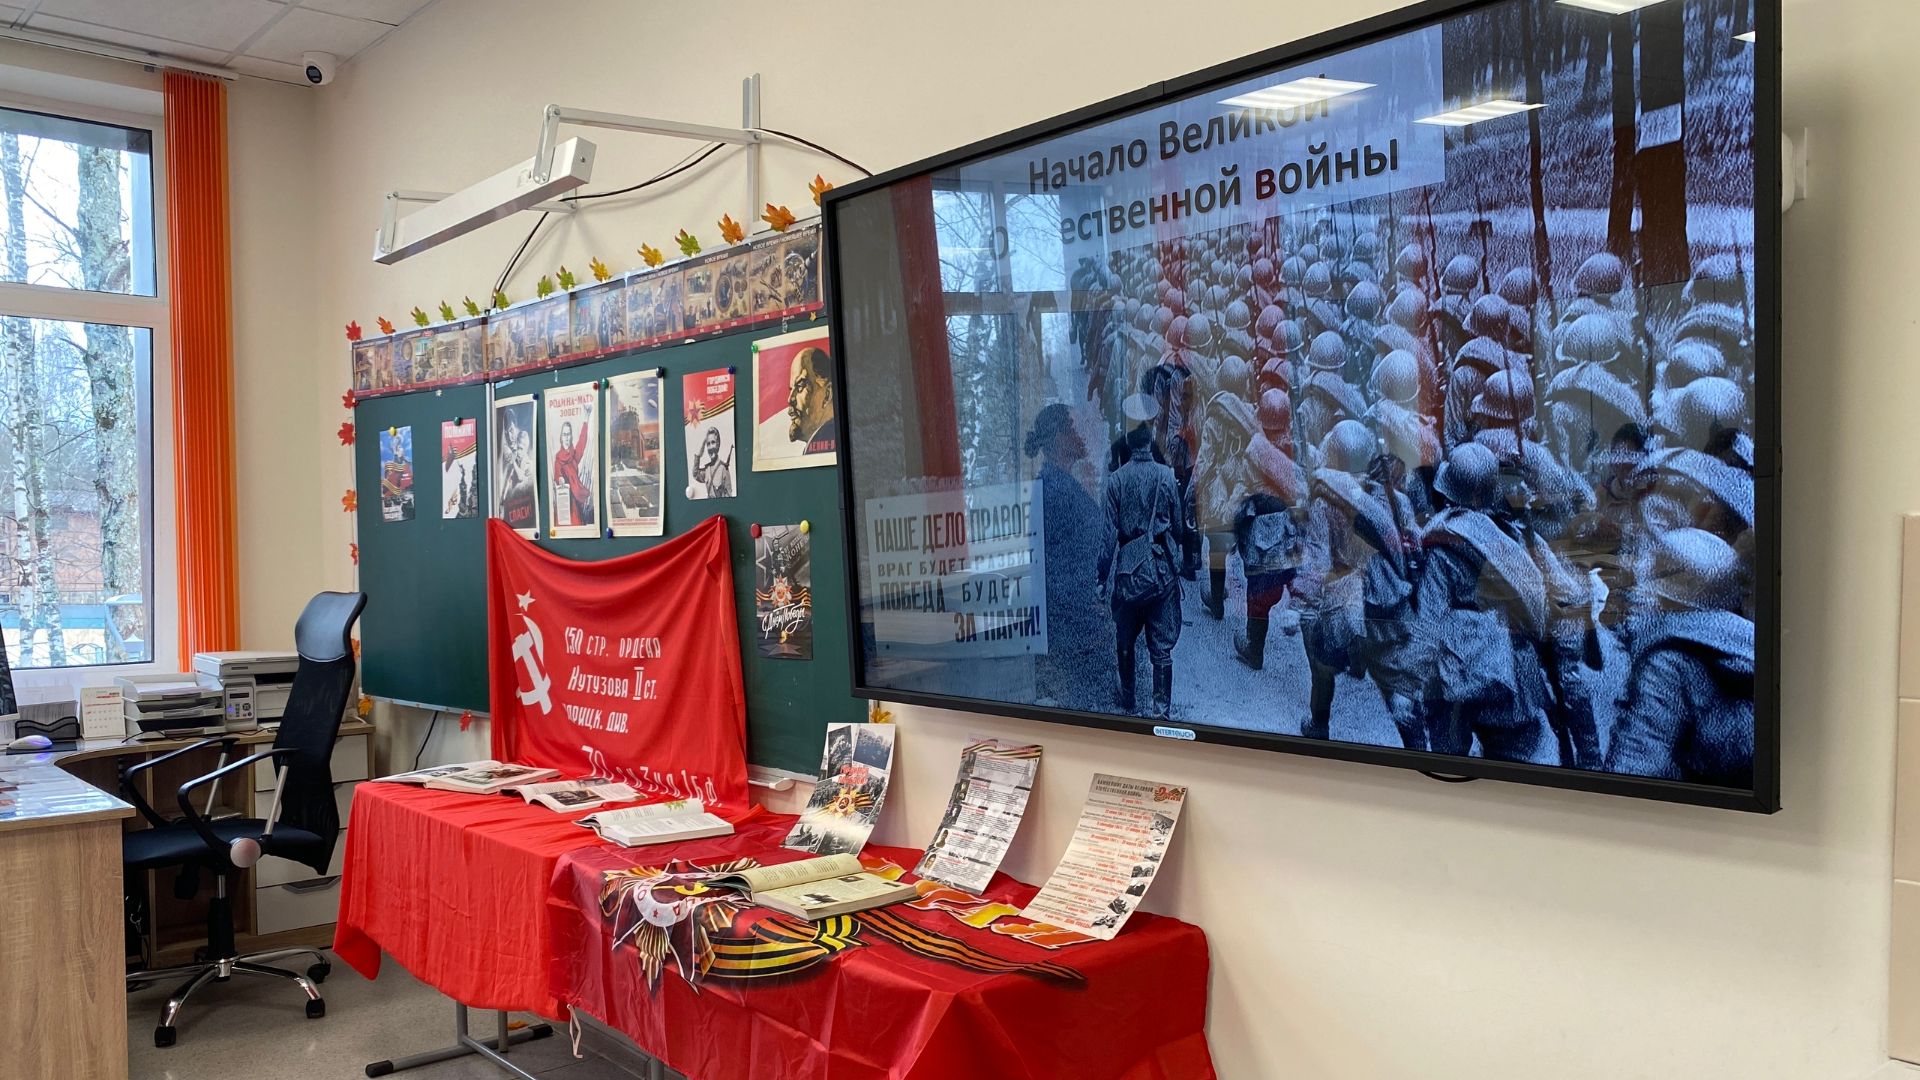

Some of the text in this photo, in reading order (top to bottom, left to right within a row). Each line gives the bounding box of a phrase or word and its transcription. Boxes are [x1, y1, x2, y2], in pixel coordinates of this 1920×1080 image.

[1029, 139, 1148, 194] Начало
[1255, 138, 1398, 200] войны
[874, 515, 919, 553] НАШЕ
[922, 511, 966, 555] ДЕЛО
[877, 562, 913, 578] ВРАГ
[919, 557, 966, 576] БУДЕТ
[879, 576, 1022, 613] ПОБЕДА БУДЕТ
[565, 626, 584, 655] 150
[953, 605, 1041, 642] ЗА НАМИ!
[1155, 727, 1194, 739] INTERTOUCH
